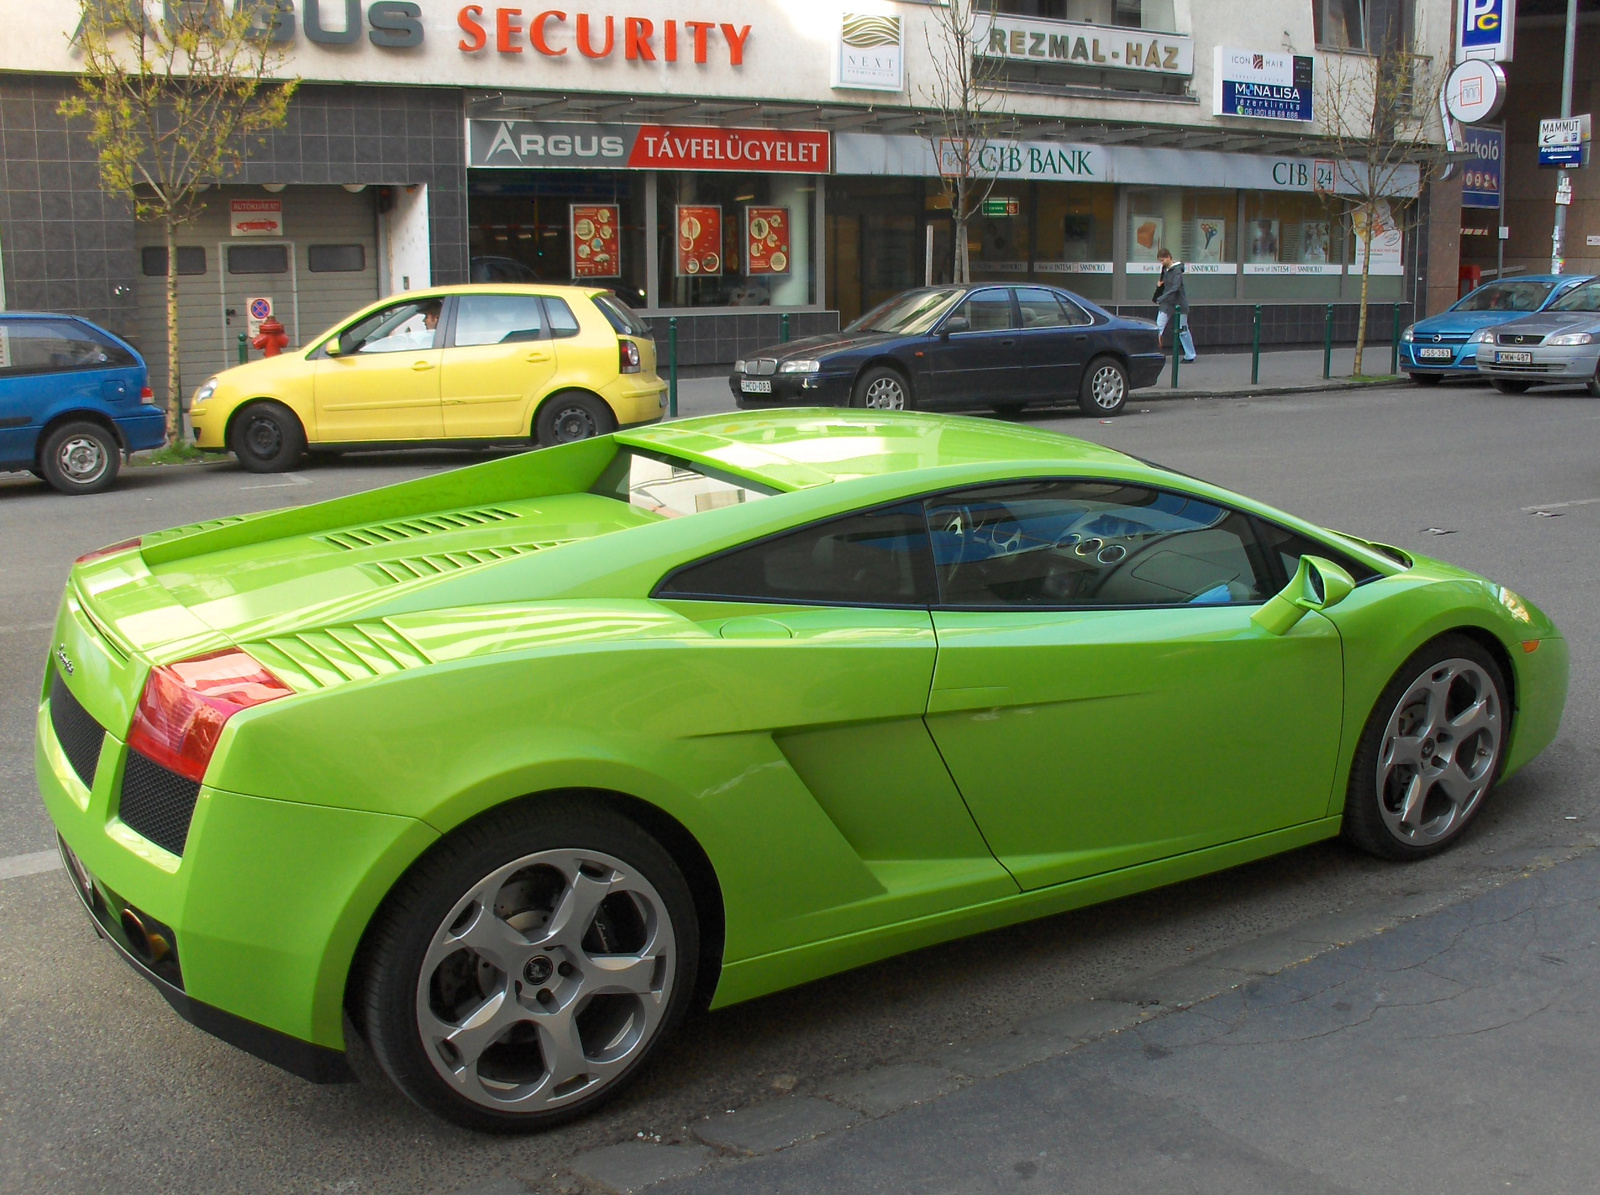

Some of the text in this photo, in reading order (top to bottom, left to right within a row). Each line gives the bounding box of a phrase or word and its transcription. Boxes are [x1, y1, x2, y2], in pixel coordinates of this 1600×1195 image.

[457, 5, 752, 66] SECURITY
[848, 55, 894, 69] NEXT
[1231, 56, 1284, 68] ICON HAIR
[1273, 87, 1300, 100] LISA
[1244, 107, 1253, 115] 06
[1542, 121, 1579, 133] MAMMUT
[644, 131, 821, 163] TÁVFELÜGYELET
[1463, 138, 1499, 160] arkoló
[978, 146, 1094, 175] CIB BANK
[1272, 162, 1332, 186] CIB 24
